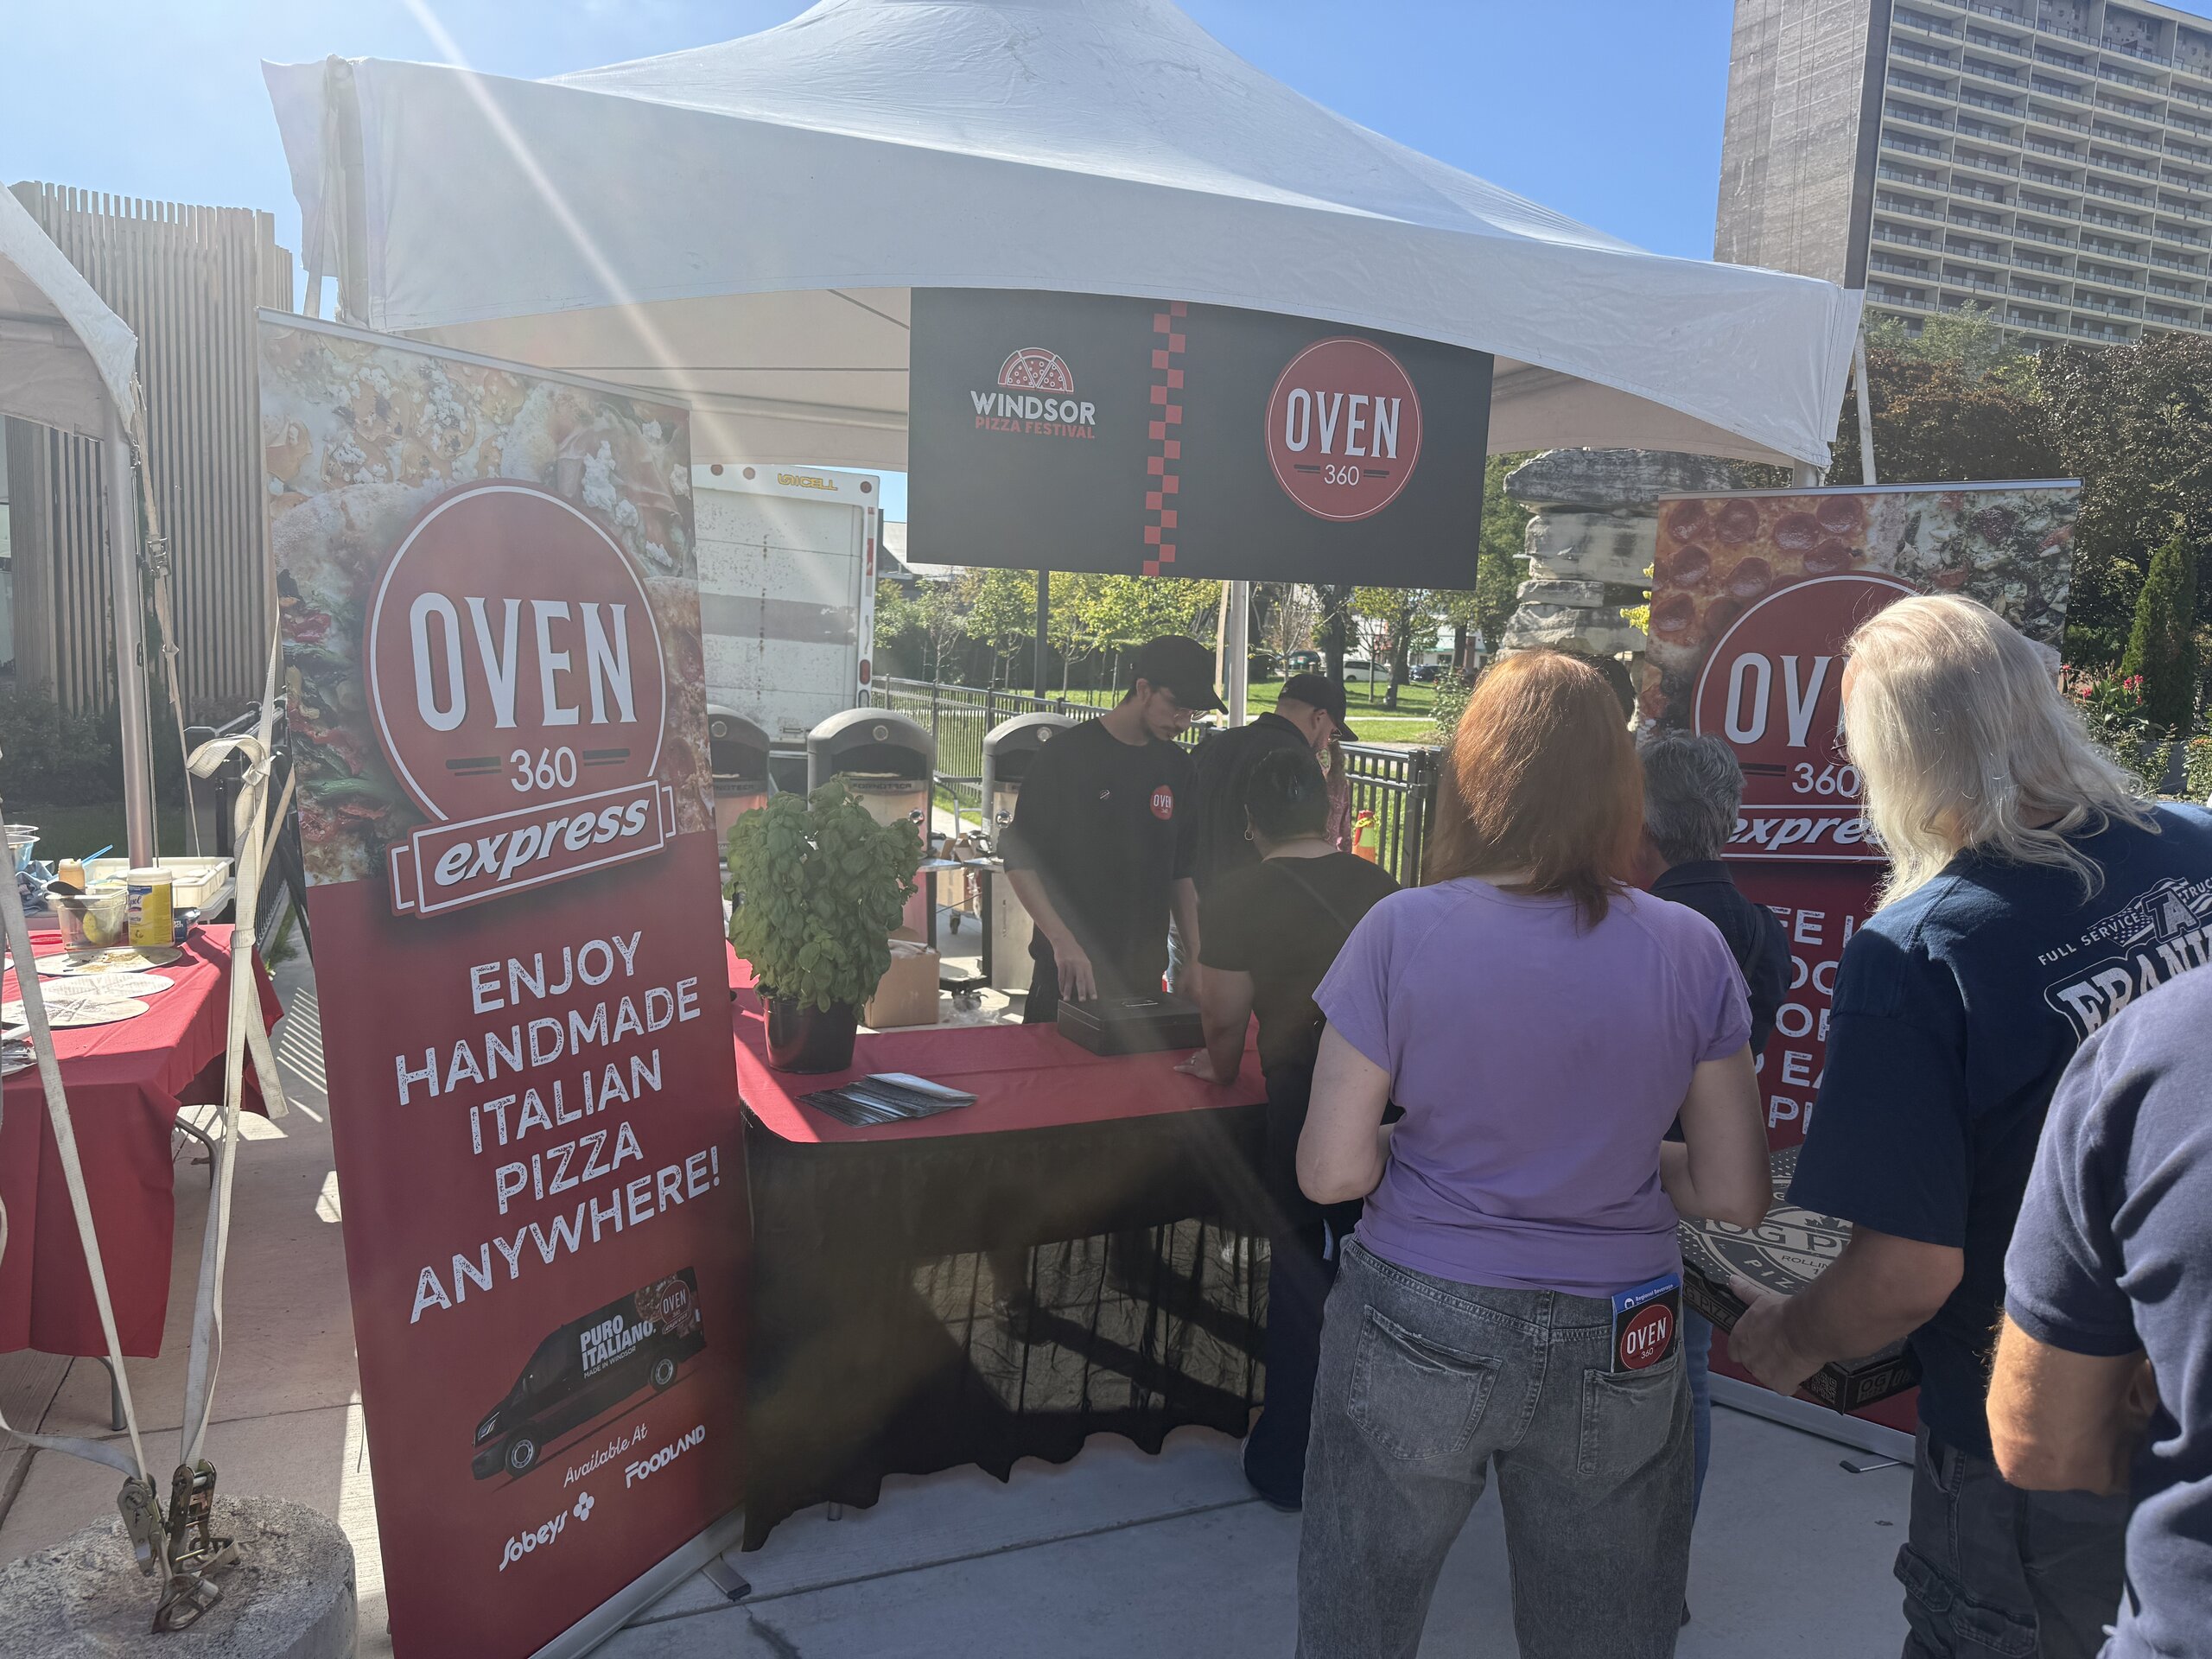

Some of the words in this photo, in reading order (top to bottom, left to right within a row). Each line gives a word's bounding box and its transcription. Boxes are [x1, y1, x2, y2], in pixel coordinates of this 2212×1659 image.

[969, 389, 1096, 426] WINDSOR
[975, 416, 1022, 433] PIZZA
[1024, 421, 1095, 440] FESTIVAL
[1285, 388, 1402, 459] OVEN
[1324, 464, 1360, 486] 360
[410, 592, 638, 732] OVEN
[1724, 652, 1847, 748] OV
[510, 747, 578, 792] 360
[1791, 762, 1861, 798] 360
[434, 798, 649, 887] express
[2037, 943, 2077, 967] FULL
[2080, 912, 2141, 947] SERVICE
[471, 931, 642, 1014] ENJOY
[395, 976, 702, 1106] HANDMADE
[469, 1048, 663, 1154] ITALIAN
[495, 1122, 644, 1215] PIZZA
[410, 1146, 721, 1324] ANYWHERE!
[663, 1288, 687, 1314] OVEN
[1635, 1290, 1654, 1302] Regional
[580, 1314, 624, 1353] PURO
[582, 1320, 657, 1371] ITALIANO.
[1626, 1317, 1667, 1355] OVEN
[1641, 1347, 1654, 1359] 360
[583, 1365, 602, 1380] MADE
[601, 1360, 609, 1370] IN
[609, 1345, 637, 1364] WINDSOR
[563, 1435, 631, 1488] Available
[631, 1422, 648, 1447] At
[625, 1425, 707, 1489] FOODLAND
[499, 1510, 569, 1573] Sobeys
